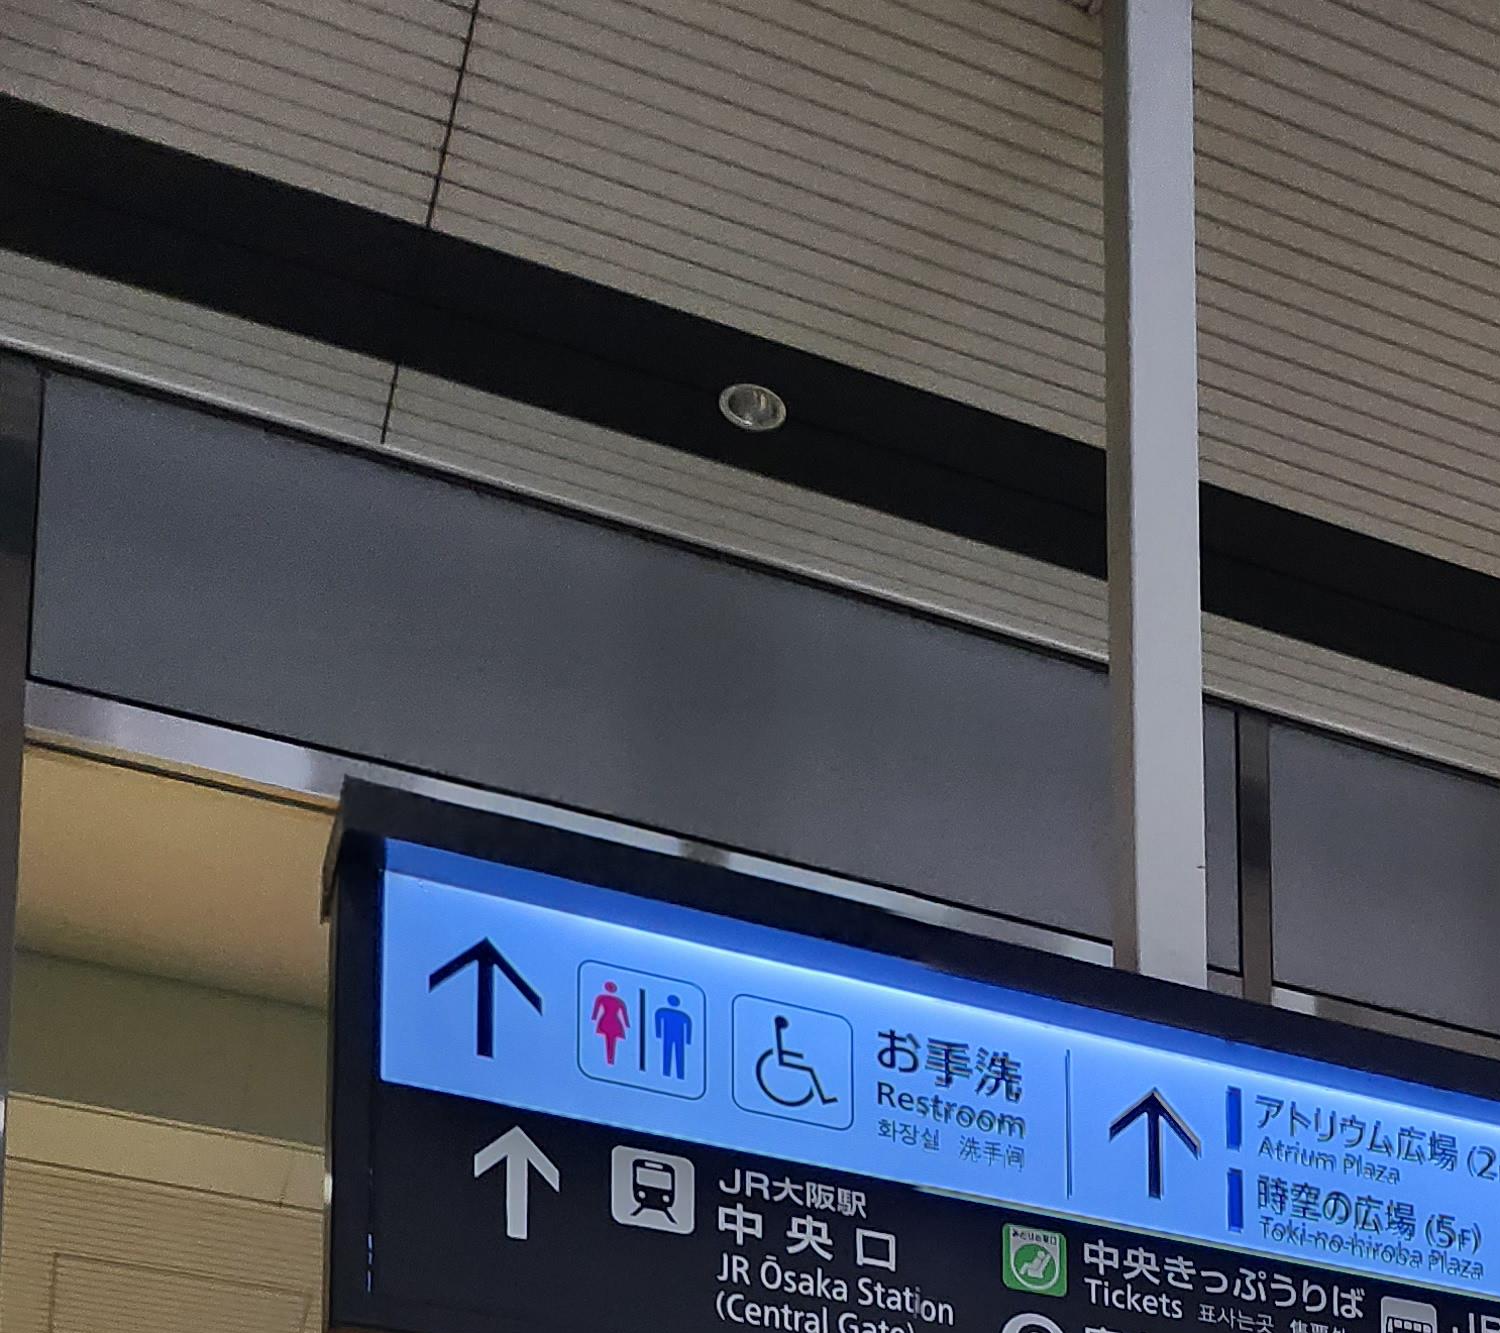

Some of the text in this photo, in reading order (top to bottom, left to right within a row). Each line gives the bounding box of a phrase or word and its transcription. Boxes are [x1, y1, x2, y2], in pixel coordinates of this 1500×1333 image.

[877, 1029, 1022, 1102] お手洗
[877, 1082, 1025, 1139] Restroom
[1256, 1095, 1458, 1172] アトリウム広場
[878, 1118, 1025, 1173] 화장실 洗手间
[1259, 1136, 1400, 1185] Atrium Plaza
[719, 1169, 866, 1219] JR大阪駅
[1257, 1174, 1416, 1241] 時空の広場
[1083, 1239, 1365, 1319] 中央きっぷうりば
[1260, 1216, 1483, 1280] Toki-no-hiroba Plaza
[716, 1253, 954, 1325] JR Ōsaka Station
[1083, 1278, 1183, 1319] Tickets
